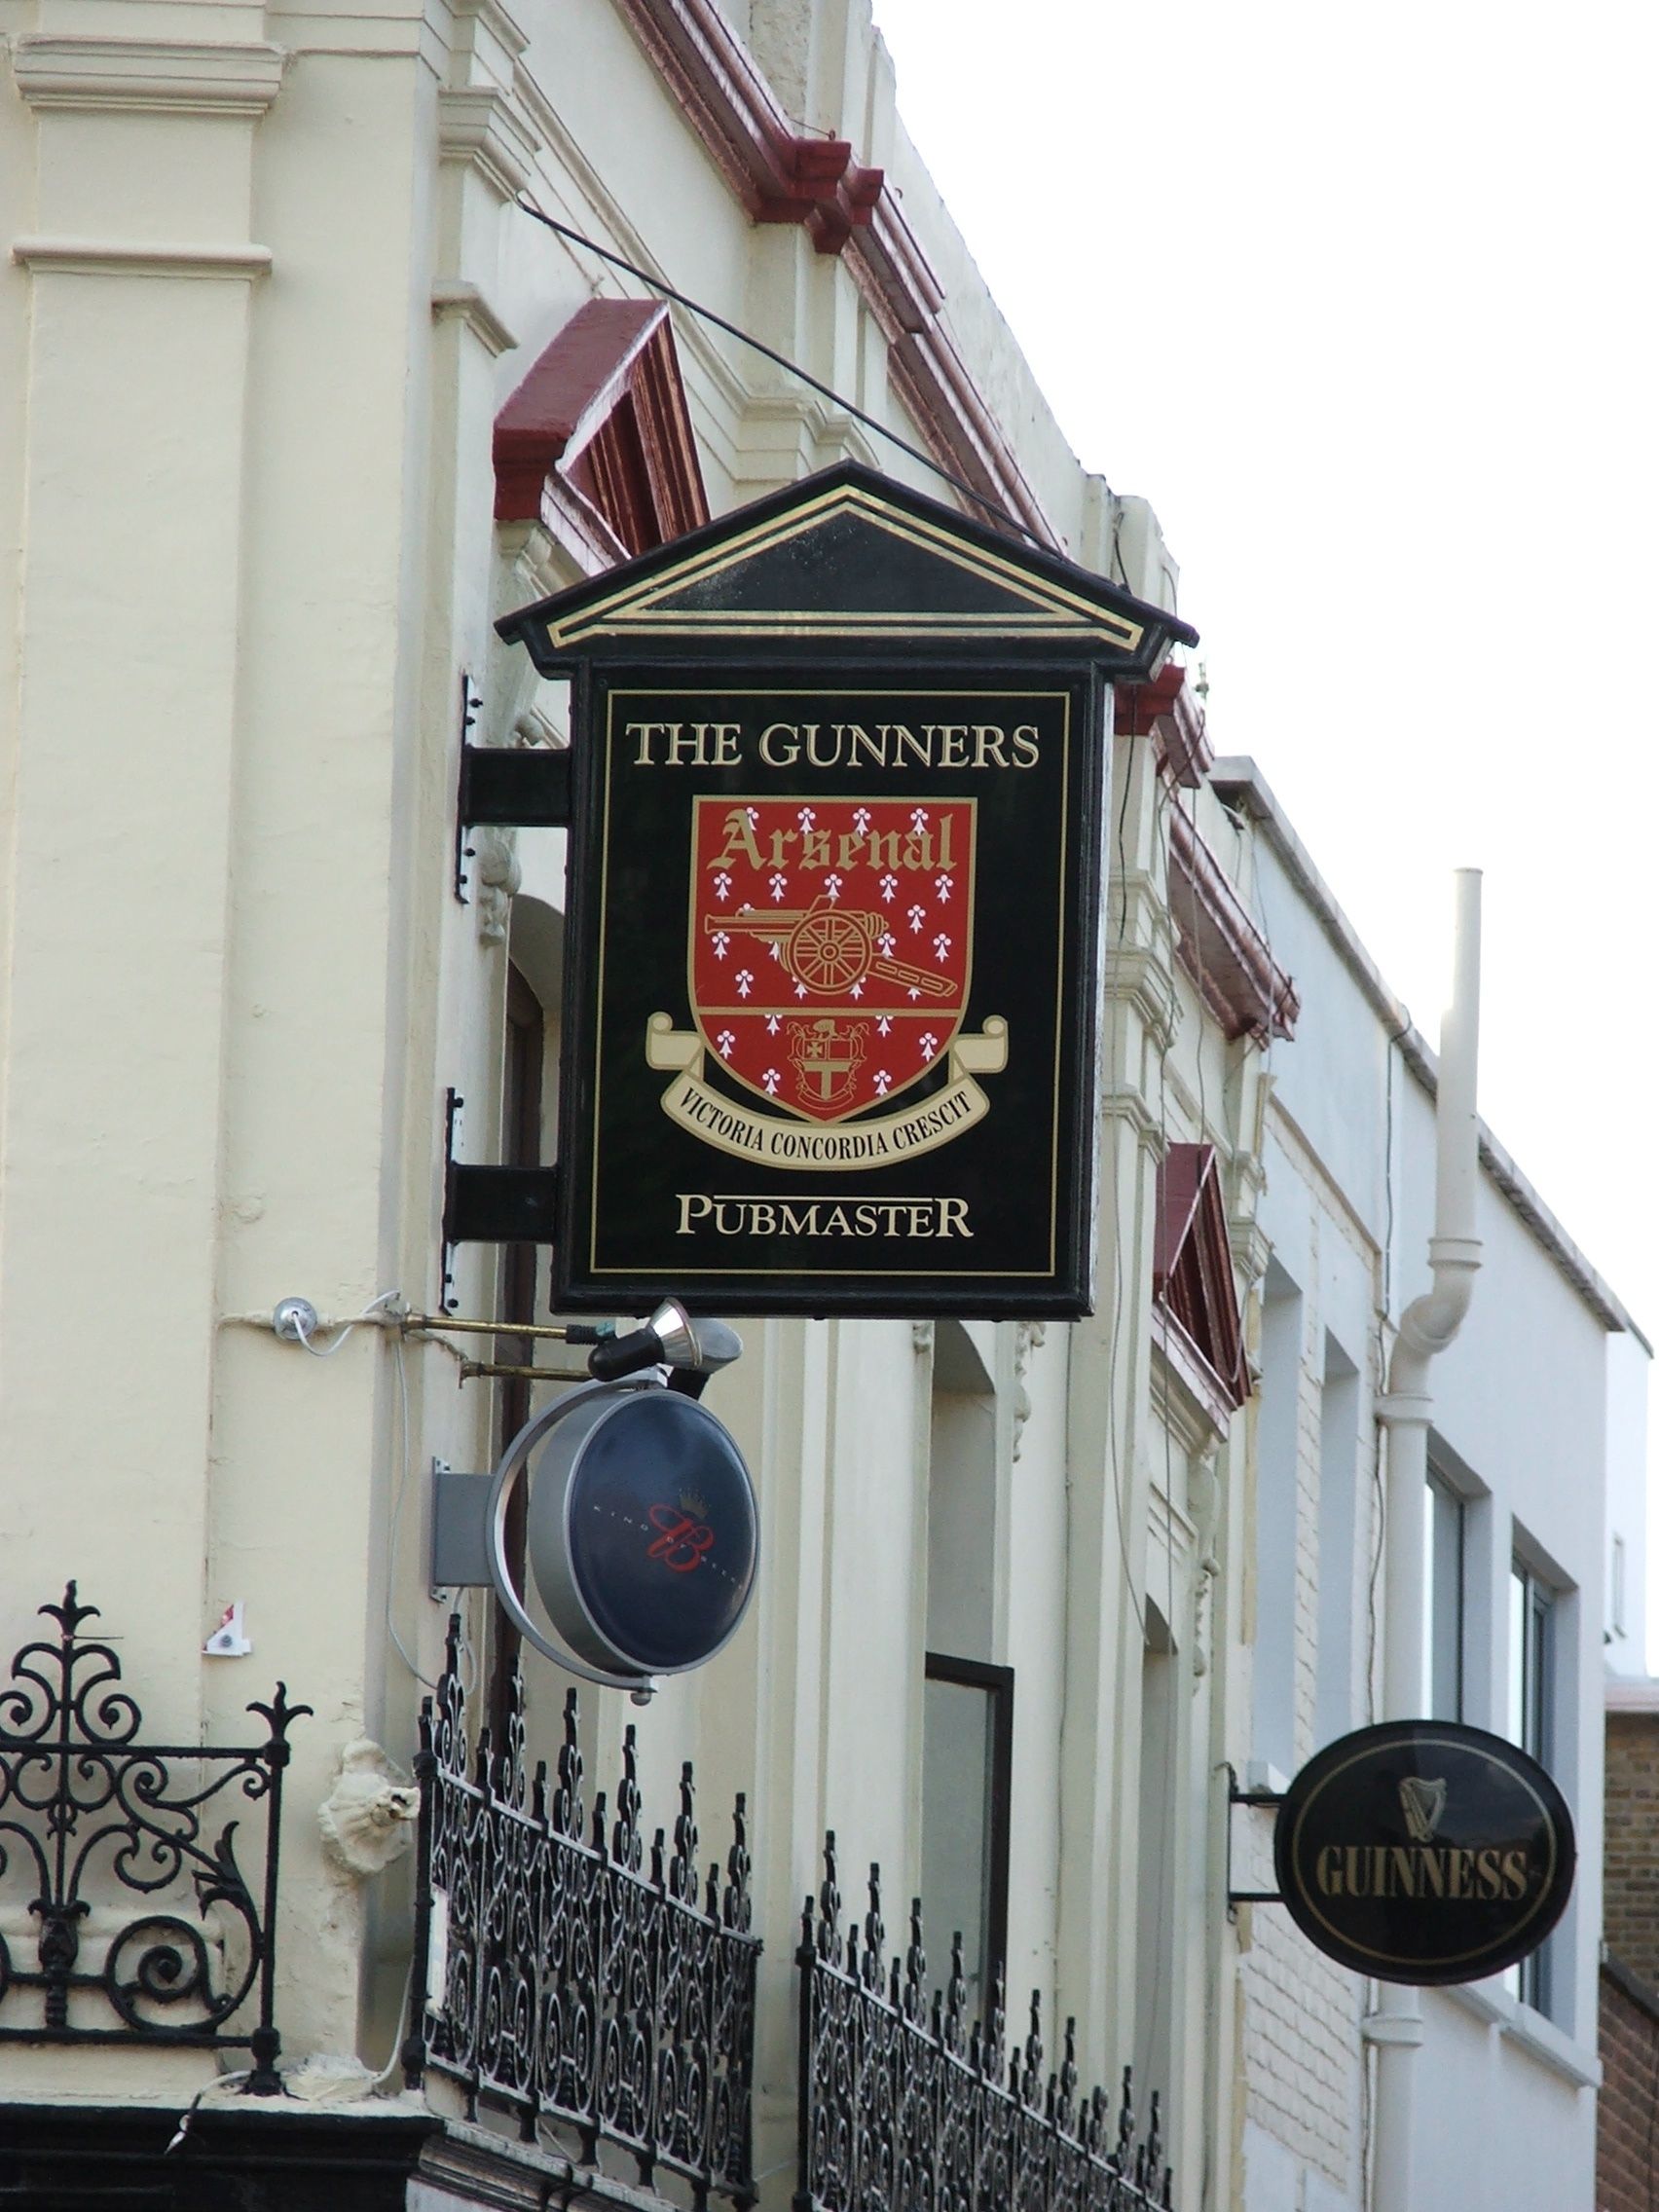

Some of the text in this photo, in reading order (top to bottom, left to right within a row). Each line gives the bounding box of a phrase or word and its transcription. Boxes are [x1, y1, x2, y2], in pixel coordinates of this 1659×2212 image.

[625, 722, 1041, 769] THE GUNNERS
[706, 807, 958, 871] Arsenal
[680, 1086, 974, 1161] VICTORIA CONCORDIA CRESCIT
[1316, 1846, 1529, 1899] GUINNESS
